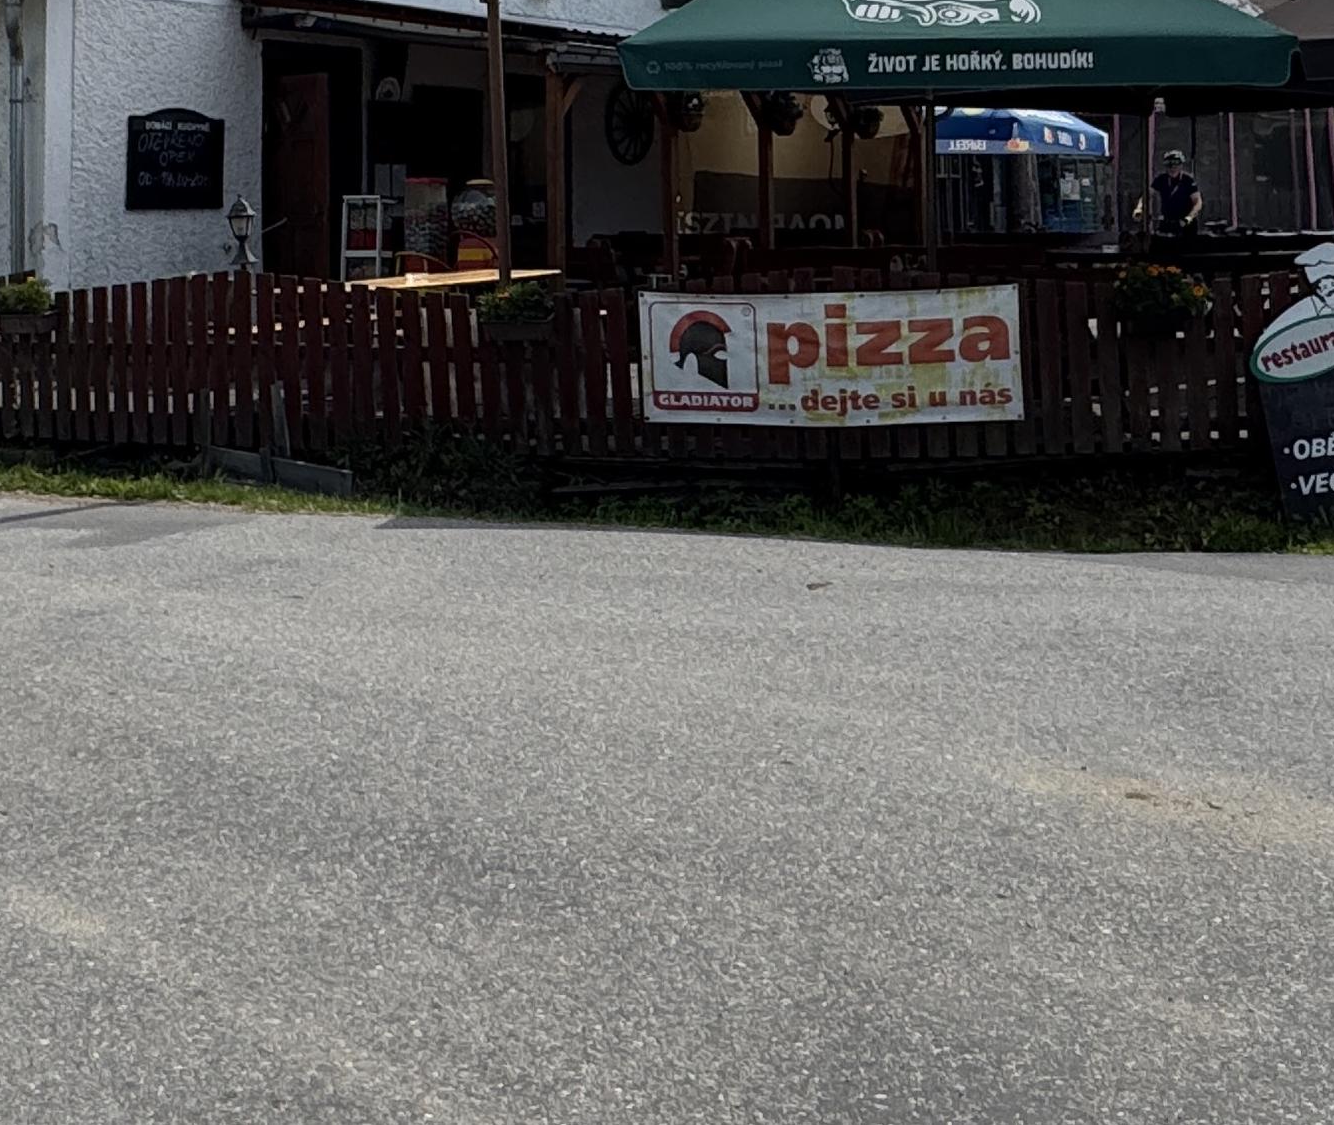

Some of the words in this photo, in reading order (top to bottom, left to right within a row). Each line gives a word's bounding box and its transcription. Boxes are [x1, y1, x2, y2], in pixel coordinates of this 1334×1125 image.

[868, 53, 916, 73] ŽIVOT
[922, 54, 940, 71] JE
[946, 50, 1007, 71] HOŘKÝ.
[1012, 49, 1094, 69] BOHUDÍK!
[767, 304, 1012, 386] pizza
[657, 393, 754, 409] GLADIATOR
[891, 386, 916, 409] si
[929, 392, 948, 407] u
[960, 383, 1012, 406] nás
